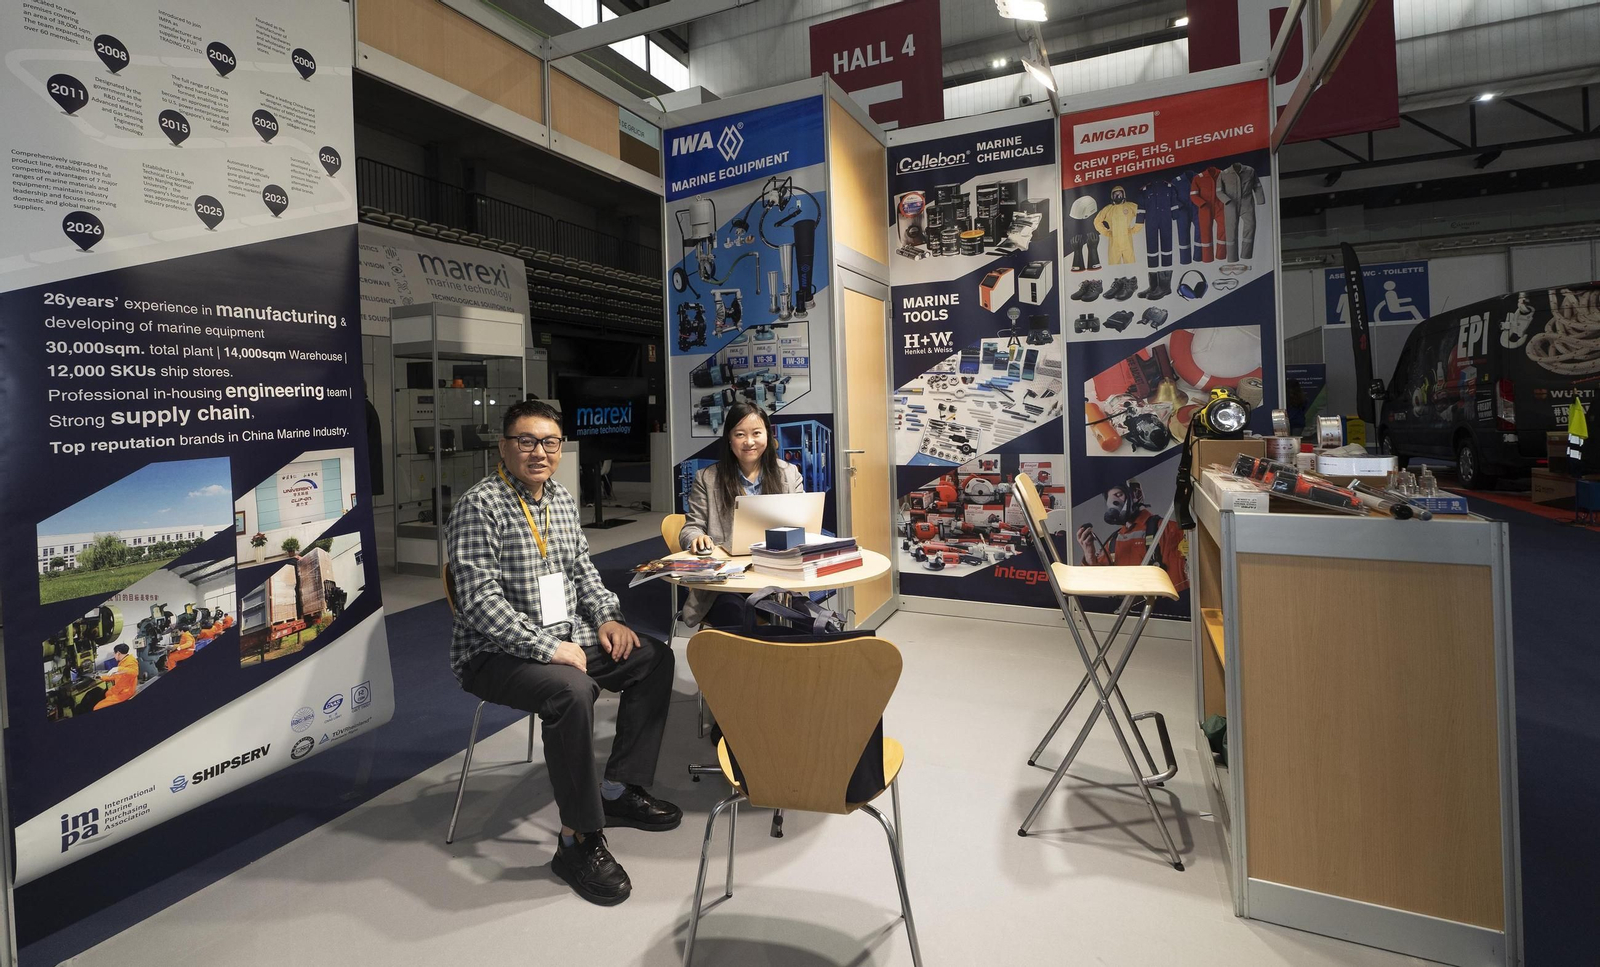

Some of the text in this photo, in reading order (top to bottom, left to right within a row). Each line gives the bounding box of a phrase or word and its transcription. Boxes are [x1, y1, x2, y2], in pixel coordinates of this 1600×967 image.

[23, 3, 79, 24] premises covering
[63, 7, 76, 15] new
[23, 16, 36, 24] The
[37, 21, 54, 30] team
[55, 26, 85, 39] expanded
[57, 19, 78, 30] 38,000
[78, 27, 93, 35] sqm.
[49, 32, 80, 45] members.
[97, 42, 127, 61] 2008
[209, 49, 235, 66] 2006
[833, 33, 916, 75] HALL 4
[293, 55, 315, 70] 2000
[51, 83, 84, 100] 2011
[161, 117, 189, 134] 2015
[254, 117, 277, 131] 2020
[976, 135, 1022, 152] MARINE
[1080, 123, 1149, 145] AMGARD
[671, 131, 714, 157] IWA
[1073, 123, 1254, 172] CREW PPE, EHS, LIFESAVING
[11, 149, 67, 163] Comprehensively
[69, 159, 98, 169] upgraded
[321, 153, 339, 166] 2021
[898, 152, 966, 173] Collebon
[976, 144, 1044, 164] CHEMICALS
[12, 157, 38, 166] product
[55, 163, 90, 174] established
[671, 150, 790, 193] MARINE EQUIPMENT
[1073, 154, 1175, 184] & FIRE FIGHTING
[12, 165, 51, 175] competitive
[52, 170, 88, 181] advantages
[101, 179, 118, 187] major
[12, 173, 35, 181] ranges
[44, 177, 68, 185] marine
[69, 180, 97, 190] materials
[12, 187, 48, 197] leadership
[62, 193, 86, 202] focuses
[96, 199, 117, 208] serving
[13, 195, 44, 203] domestic
[52, 185, 83, 195] maintains
[84, 190, 108, 199] industry
[264, 192, 287, 205] 2023
[13, 203, 46, 212] suppliers.
[197, 204, 223, 217] 2025
[66, 221, 102, 235] 2026
[417, 252, 510, 289] marexi
[1383, 266, 1425, 275] TOILETTE
[359, 277, 391, 287] CROWAVE
[425, 277, 512, 302] marine technology
[431, 293, 480, 307] TECHNOLOGICAL
[903, 293, 960, 309] MARINE
[124, 299, 198, 315] experience
[201, 304, 212, 316] in
[216, 304, 337, 329] manufacturing
[340, 317, 347, 327] &
[903, 308, 949, 324] TOOLS
[44, 315, 265, 339] developing of marine equipment
[1457, 311, 1490, 359] EPI
[45, 341, 343, 362] 30,000sqm. total plant 14,000sqm Warehouse
[904, 348, 927, 356] Henkel
[933, 346, 954, 354] Weiss
[786, 357, 805, 365] IW-38
[47, 364, 233, 380] 12,000 SKUs ship stores.
[48, 383, 348, 402] Professional in-housing engineering team
[49, 414, 105, 429] Strong
[110, 405, 191, 428] supply
[576, 401, 632, 426] marexi
[576, 425, 632, 436] marine technology
[49, 426, 350, 456] Top reputation brands in China Marine Industry.
[994, 565, 1050, 585] intega
[191, 743, 271, 785] SHIPSERV
[104, 784, 156, 810] International
[104, 801, 133, 817] Marine
[104, 802, 148, 825] Purchasing
[60, 806, 99, 835] im
[104, 808, 151, 831] Association
[61, 823, 99, 853] pa
